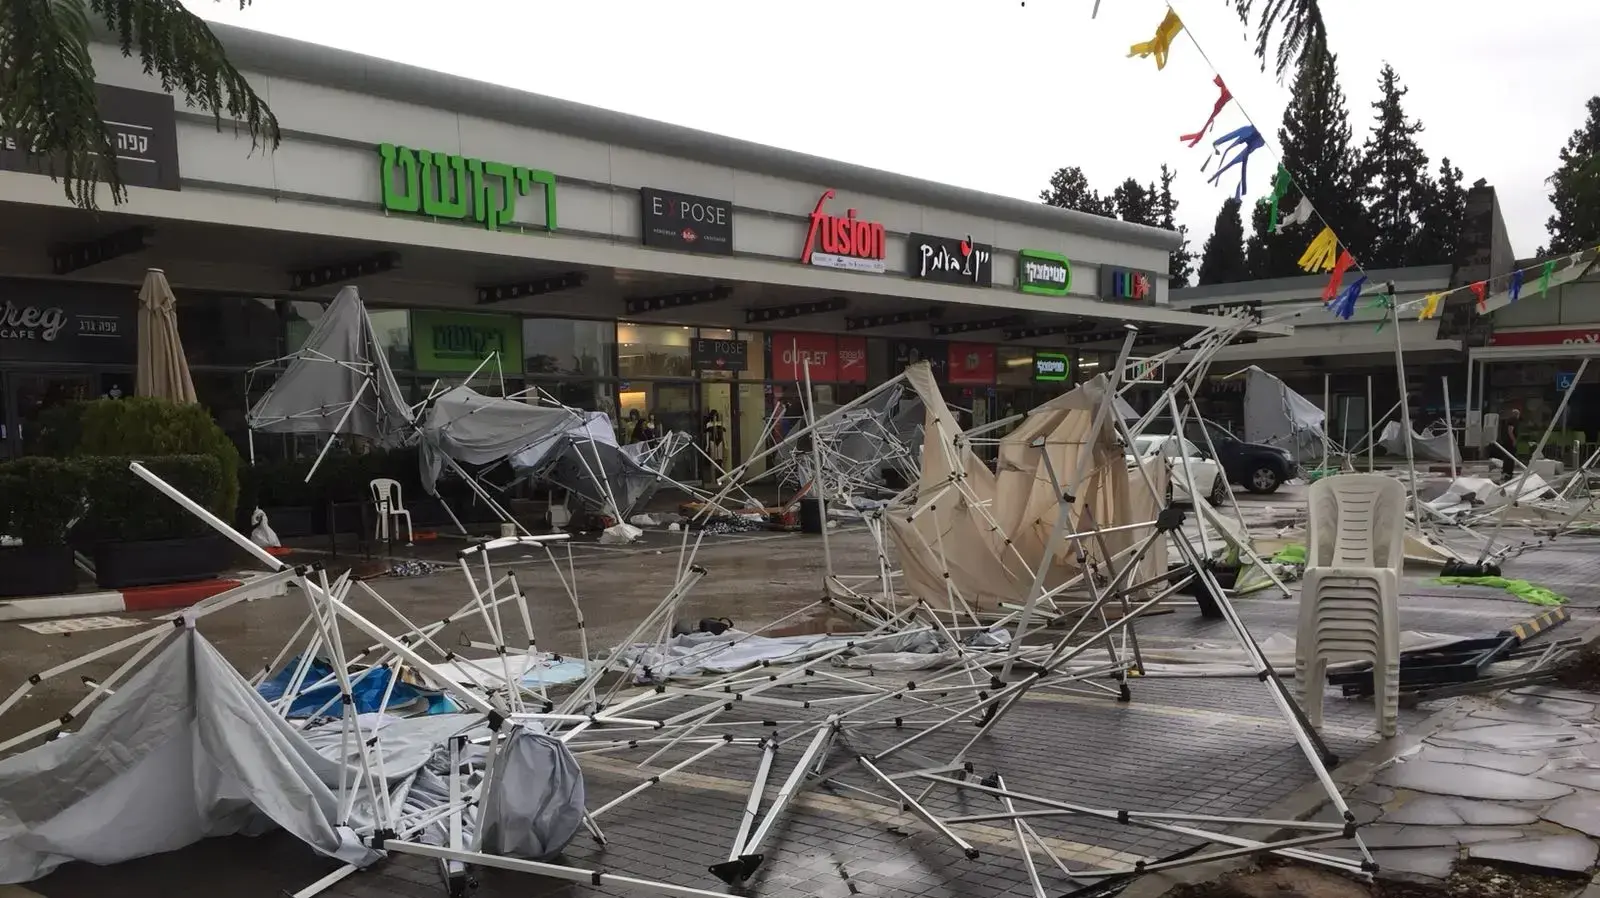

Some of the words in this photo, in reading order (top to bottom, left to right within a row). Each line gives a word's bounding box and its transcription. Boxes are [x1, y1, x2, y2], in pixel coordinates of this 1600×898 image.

[117, 132, 148, 153] קפה
[380, 143, 557, 231] ריקושט
[653, 196, 726, 225] EXPOSE
[801, 188, 885, 265] fusion
[920, 244, 960, 277] בעמק
[975, 250, 989, 282] יין
[1026, 261, 1067, 283] סטימצקי
[0, 300, 67, 341] reg
[99, 320, 117, 332] קפה
[0, 329, 35, 339] CAFE
[698, 341, 743, 354] EPOSE
[782, 350, 828, 365] OUTLET
